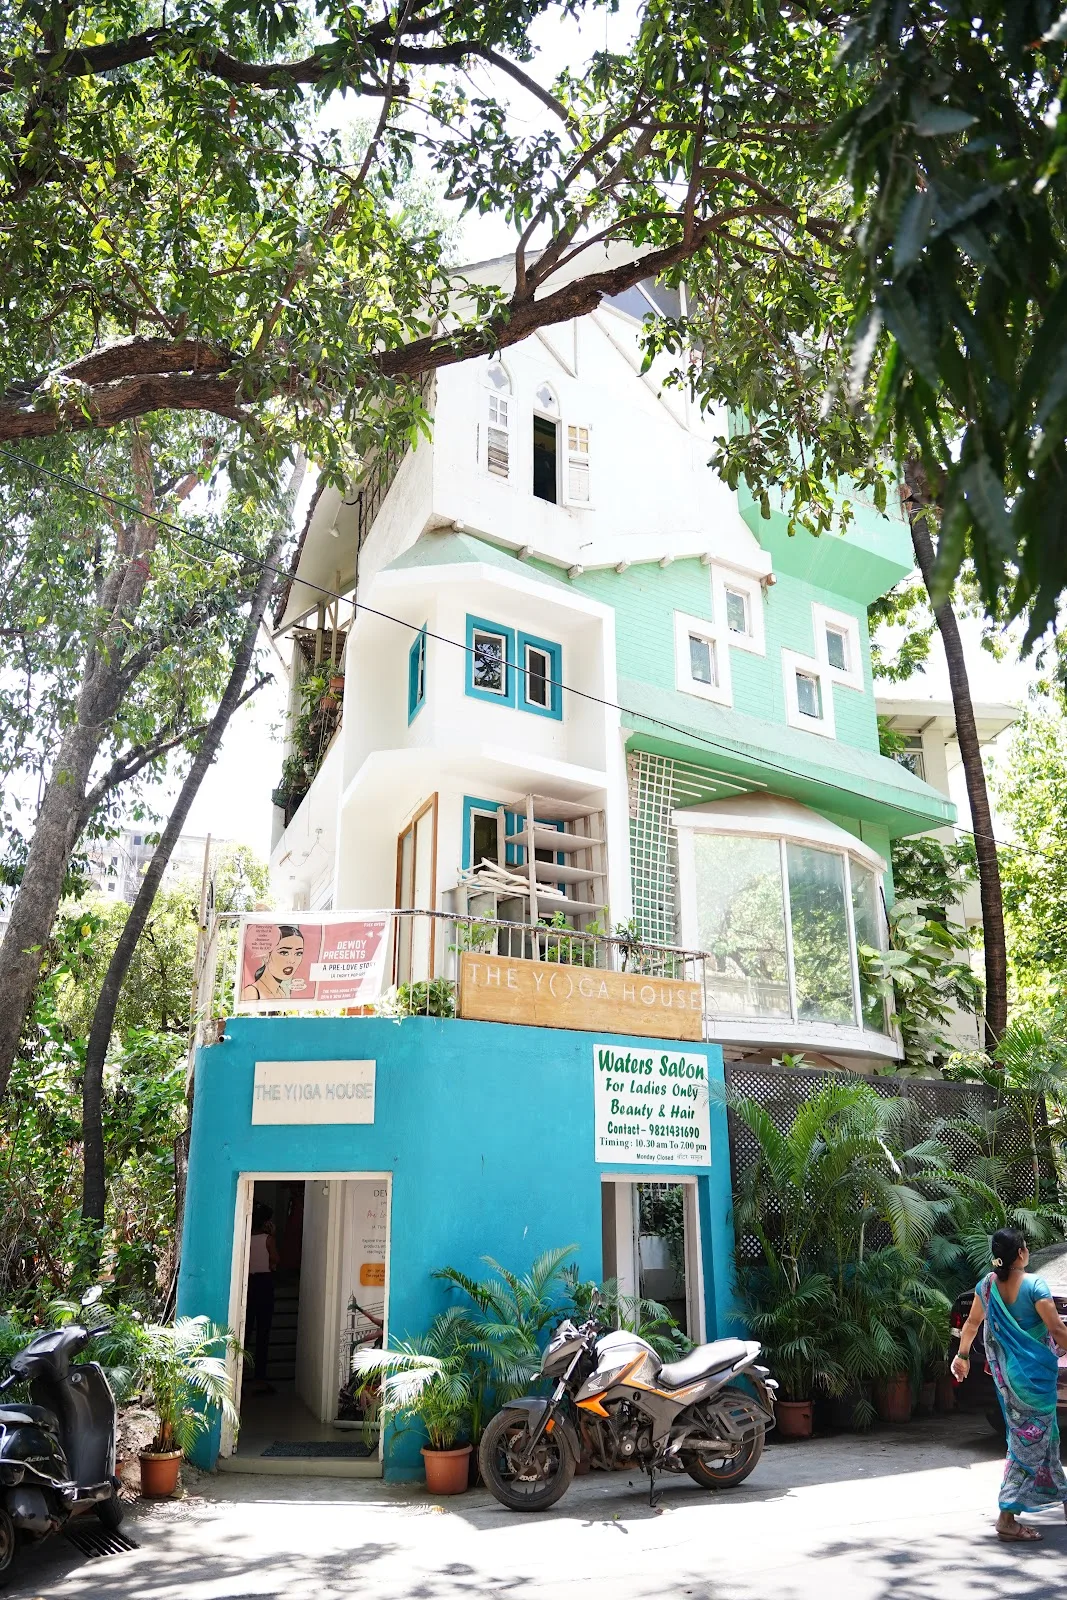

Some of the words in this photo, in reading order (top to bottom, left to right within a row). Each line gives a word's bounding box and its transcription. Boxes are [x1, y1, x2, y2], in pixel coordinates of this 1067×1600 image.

[323, 950, 366, 960] PRESENTS
[468, 963, 518, 989] THE
[623, 983, 701, 1011] HOUSE
[598, 1049, 653, 1075] Waters
[659, 1055, 705, 1080] Salon
[254, 1084, 281, 1101] THE
[325, 1083, 373, 1100] HOUSE
[606, 1078, 625, 1092] For
[630, 1079, 667, 1096] Ladies
[672, 1083, 698, 1101] Only
[610, 1098, 653, 1120] Beauty
[658, 1104, 666, 1118] &
[670, 1105, 695, 1120] Hair
[649, 1123, 700, 1139] 9821431690
[656, 1141, 668, 1149] am
[669, 1140, 679, 1149] To
[696, 1143, 707, 1153] pm
[636, 1153, 655, 1161] Monday
[656, 1153, 674, 1161] Closed
